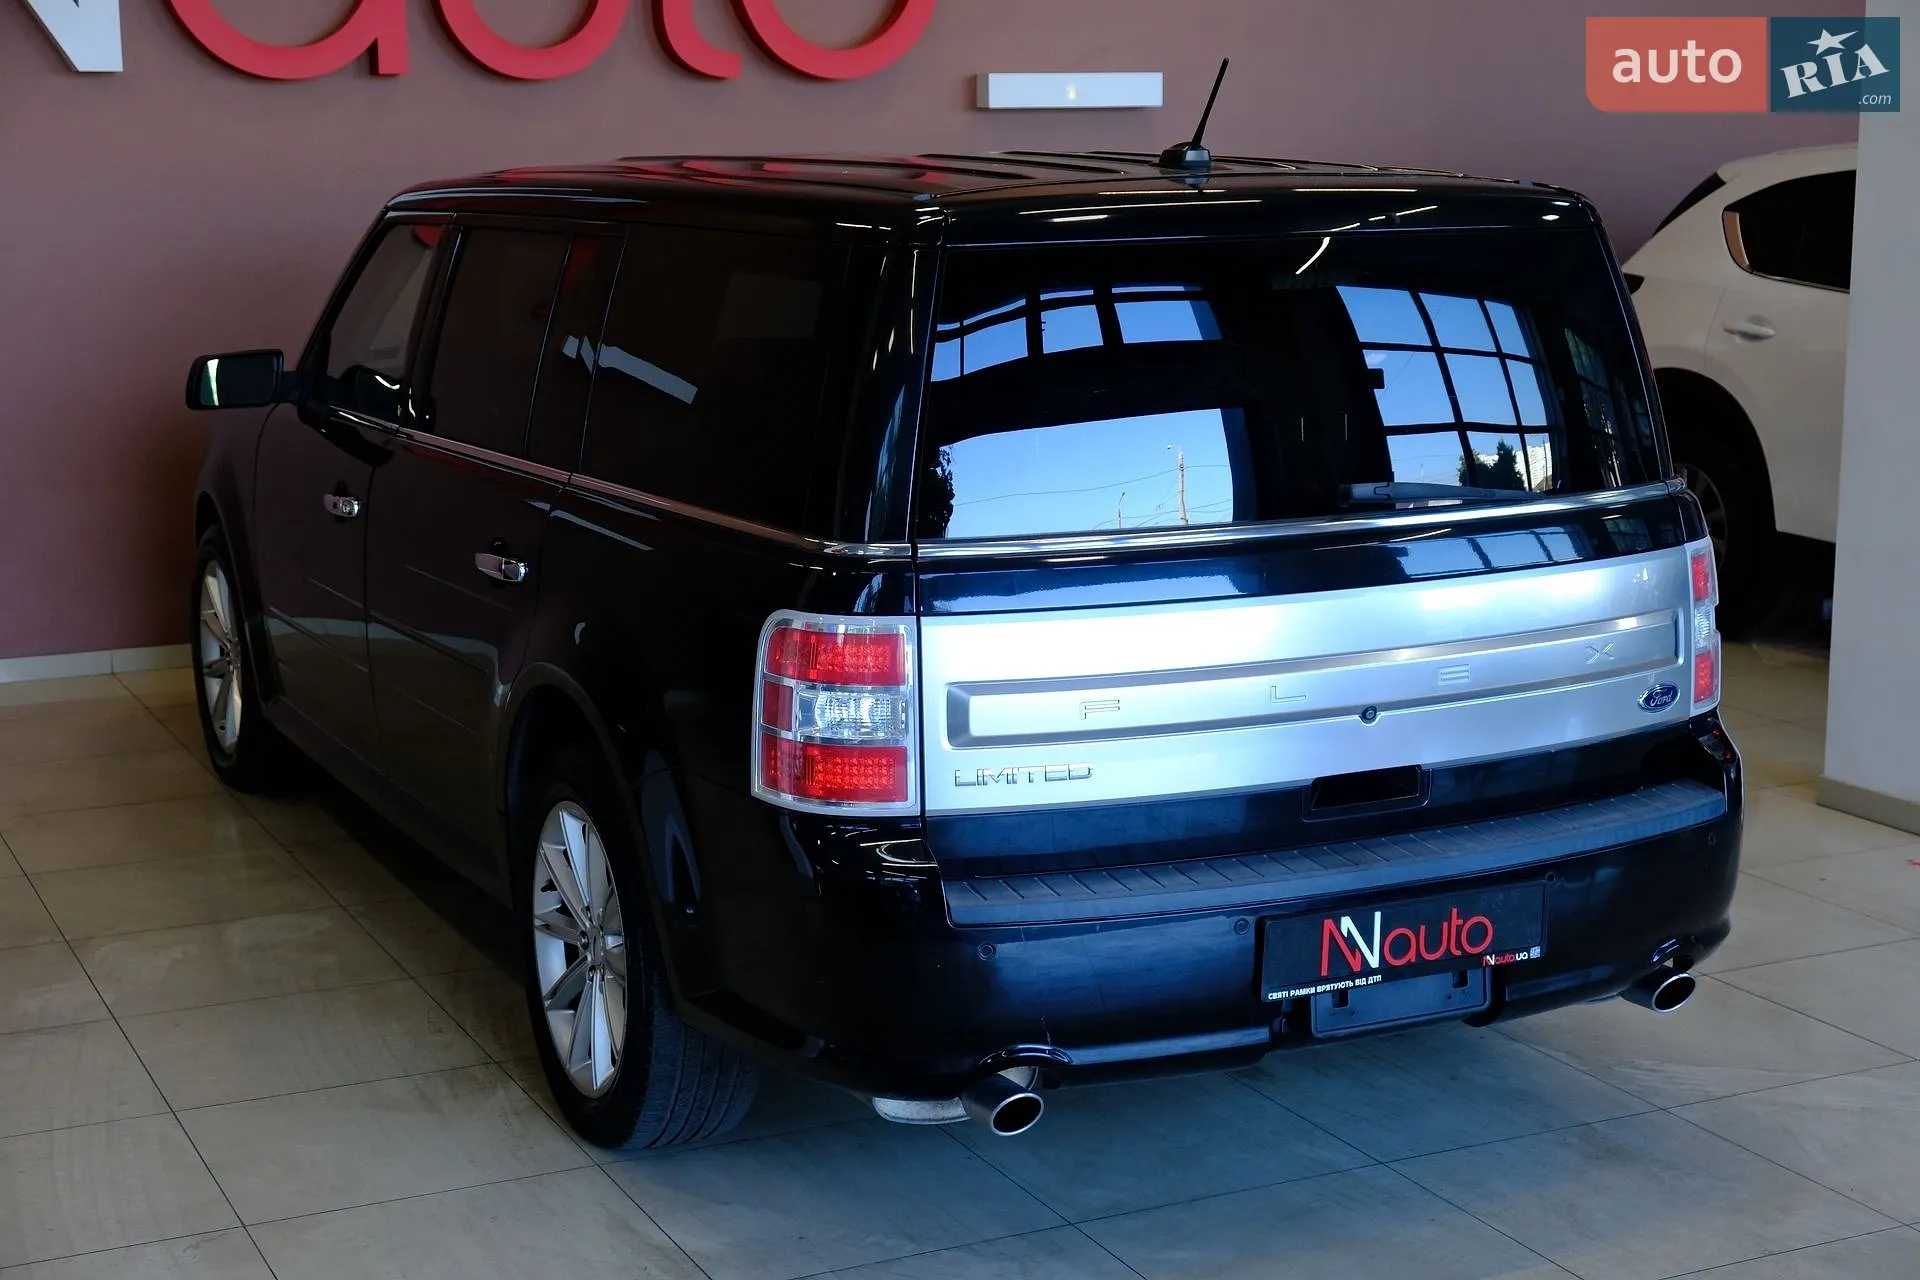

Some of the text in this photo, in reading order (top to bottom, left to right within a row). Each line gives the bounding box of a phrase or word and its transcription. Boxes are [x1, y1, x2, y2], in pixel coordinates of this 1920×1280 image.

[1650, 689, 1674, 707] Ford
[954, 762, 1094, 787] LIMITED
[1268, 990, 1289, 1000] СВЯТІ
[1289, 986, 1316, 997] РАМКИ
[1354, 977, 1367, 986] ВІД
[1367, 974, 1382, 984] ДТП
